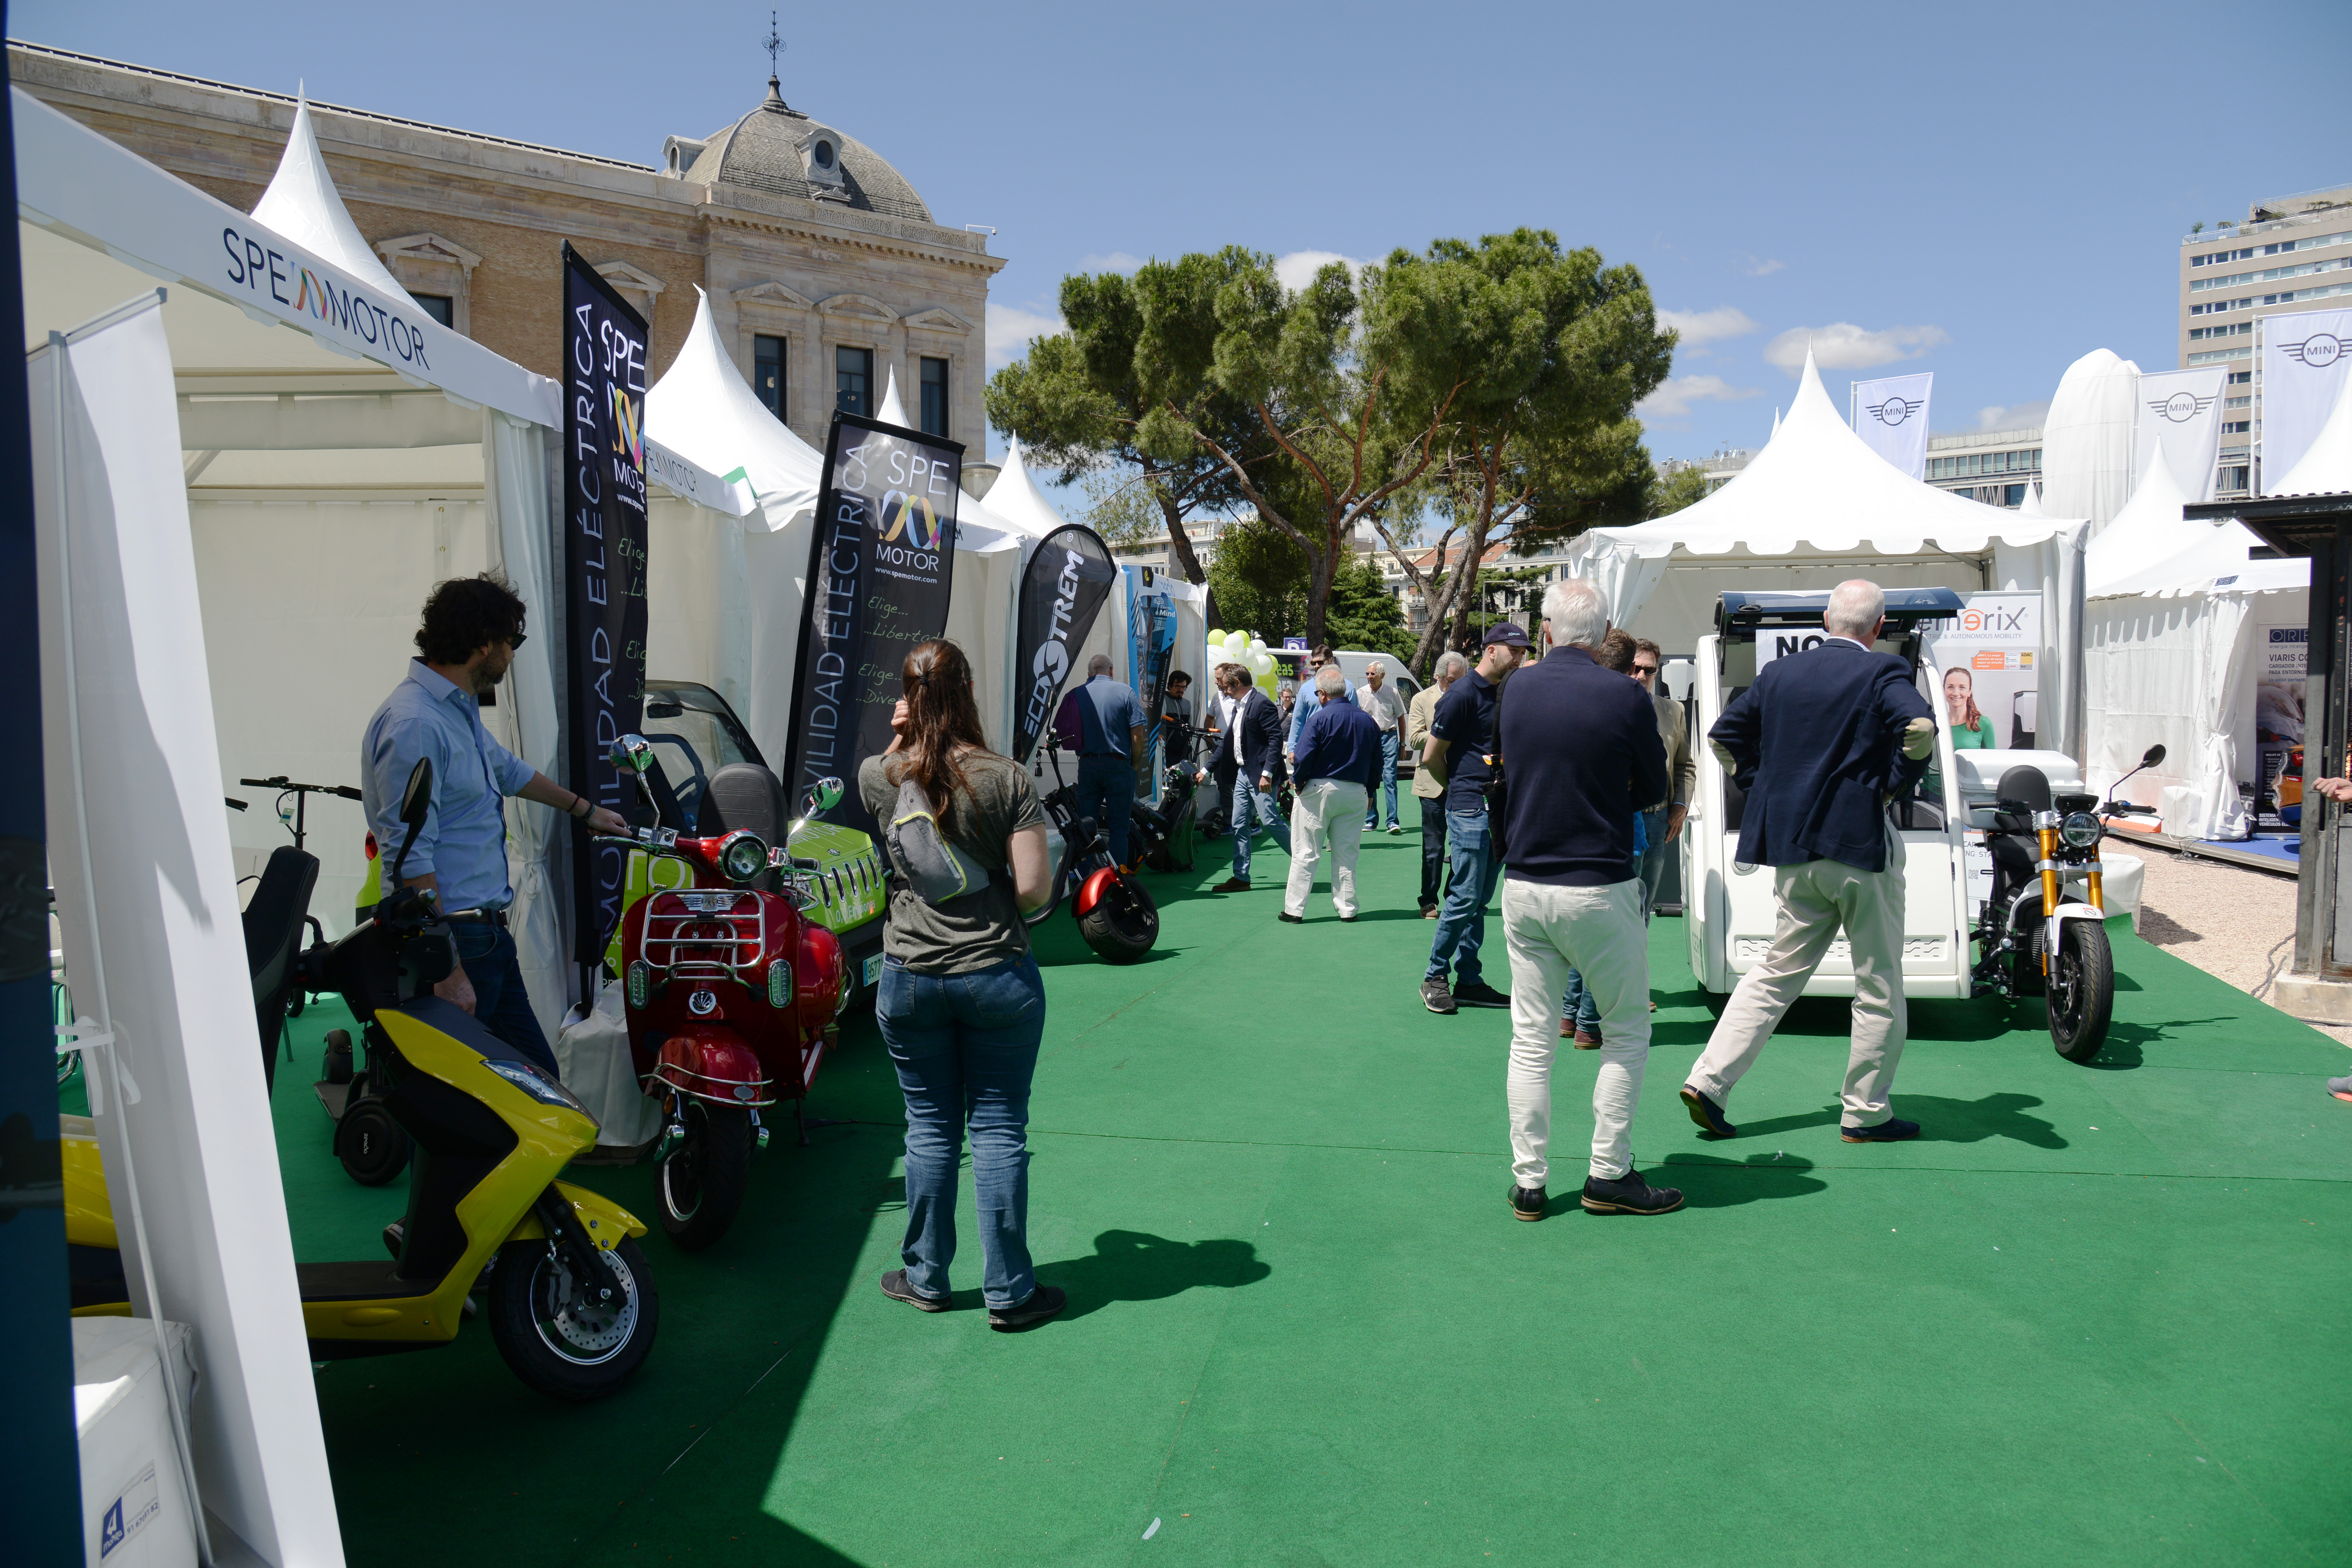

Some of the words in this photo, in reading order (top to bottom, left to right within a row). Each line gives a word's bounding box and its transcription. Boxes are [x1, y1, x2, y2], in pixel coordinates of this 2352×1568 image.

[223, 227, 290, 306] SPE
[325, 279, 430, 371] MOTOR
[601, 320, 646, 393] SPE
[2306, 345, 2336, 356] MINI
[1885, 407, 1904, 416] MINI
[2169, 403, 2193, 412] MINI
[663, 454, 700, 495] MOTOR
[887, 450, 949, 496] SPE
[821, 444, 871, 639] ELÉCTRICA
[876, 543, 939, 572] MOTOR
[875, 567, 937, 584] www.spemotor.com
[1159, 609, 1176, 618] Mind
[800, 651, 845, 820] OVILIDAD
[848, 899, 876, 918] Emisiones
[127, 1525, 134, 1534] 91
[151, 1502, 159, 1512] 82
